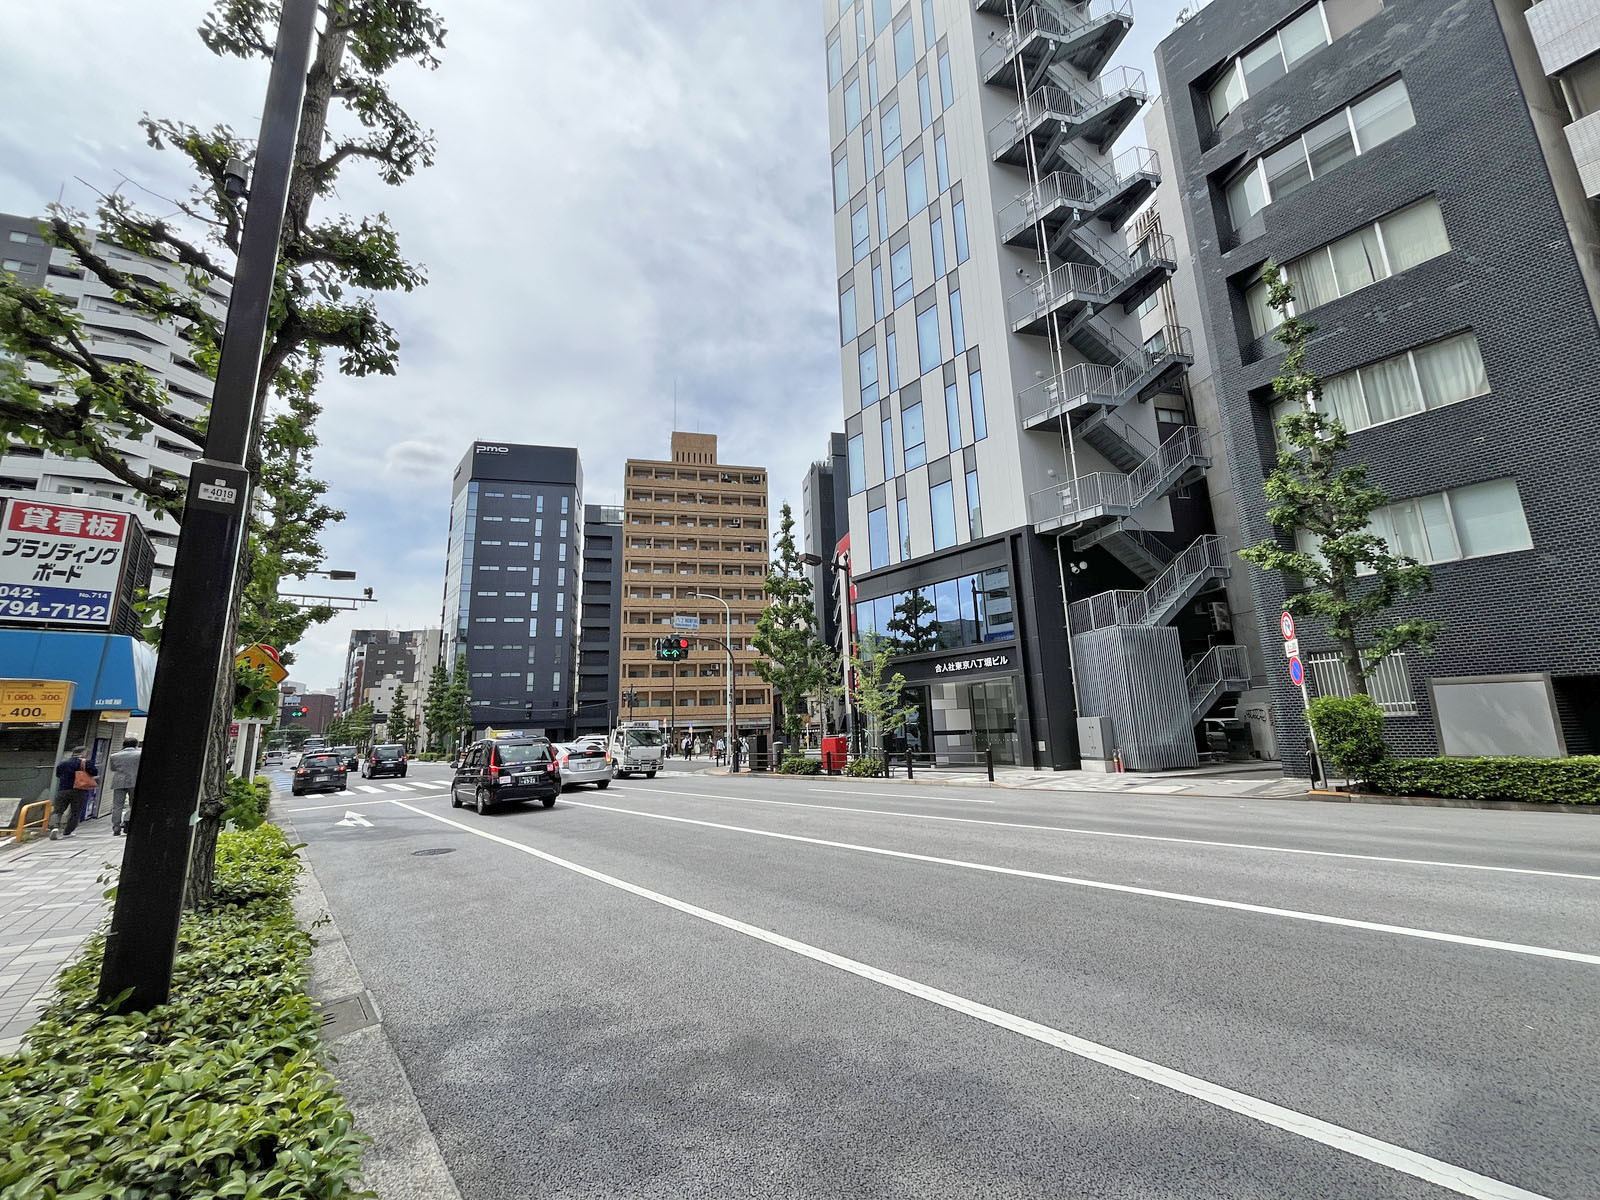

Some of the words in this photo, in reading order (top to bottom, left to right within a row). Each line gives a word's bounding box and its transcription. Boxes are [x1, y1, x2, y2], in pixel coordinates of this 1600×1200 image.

[476, 445, 509, 454] pmo
[210, 488, 234, 499] 4019
[19, 506, 119, 538] 貸看板
[2, 537, 120, 565] ブランディング
[32, 562, 84, 583] ボード
[0, 599, 106, 620] 794-7122
[935, 655, 1008, 673] 合人社東京八丁堀ビル
